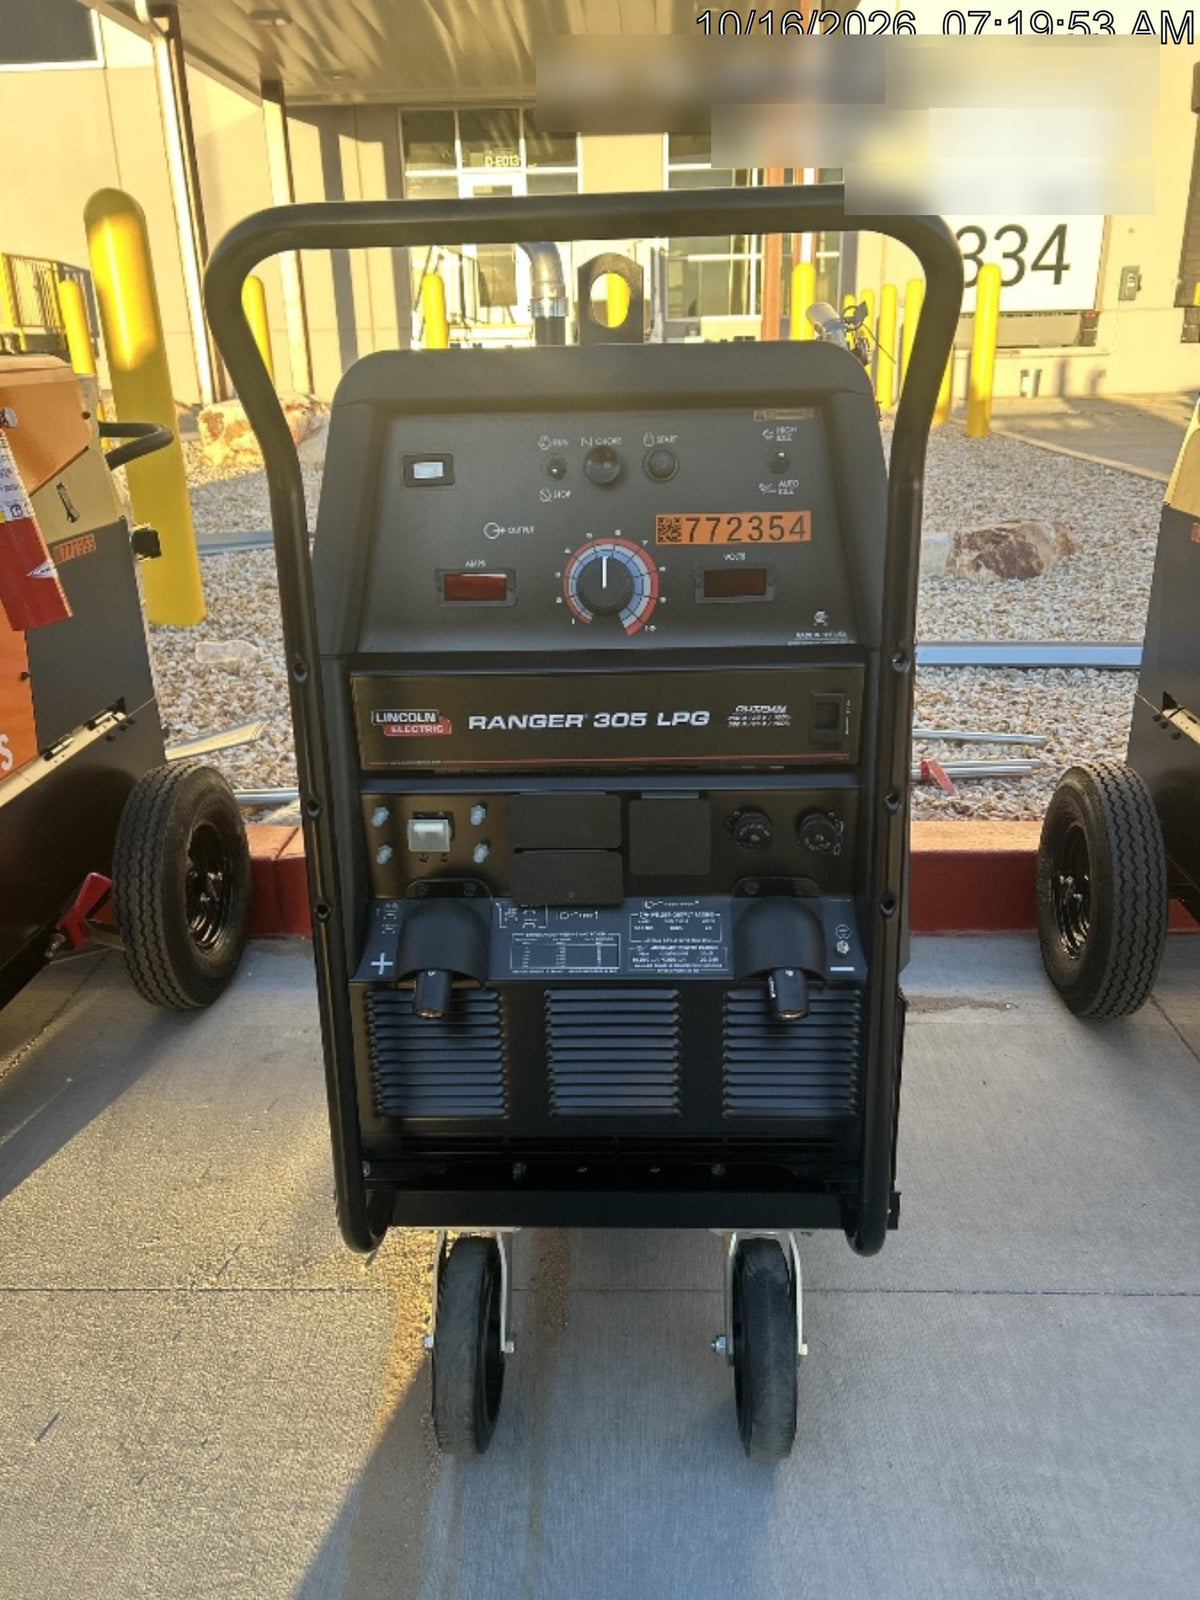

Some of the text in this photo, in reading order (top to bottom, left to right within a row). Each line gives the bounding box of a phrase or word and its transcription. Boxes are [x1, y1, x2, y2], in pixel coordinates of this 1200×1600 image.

[685, 514, 807, 543] 772354
[376, 712, 437, 723] LINCOLN
[468, 711, 711, 730] RANGER 305 LPG
[391, 724, 444, 734] ELECTRIC
